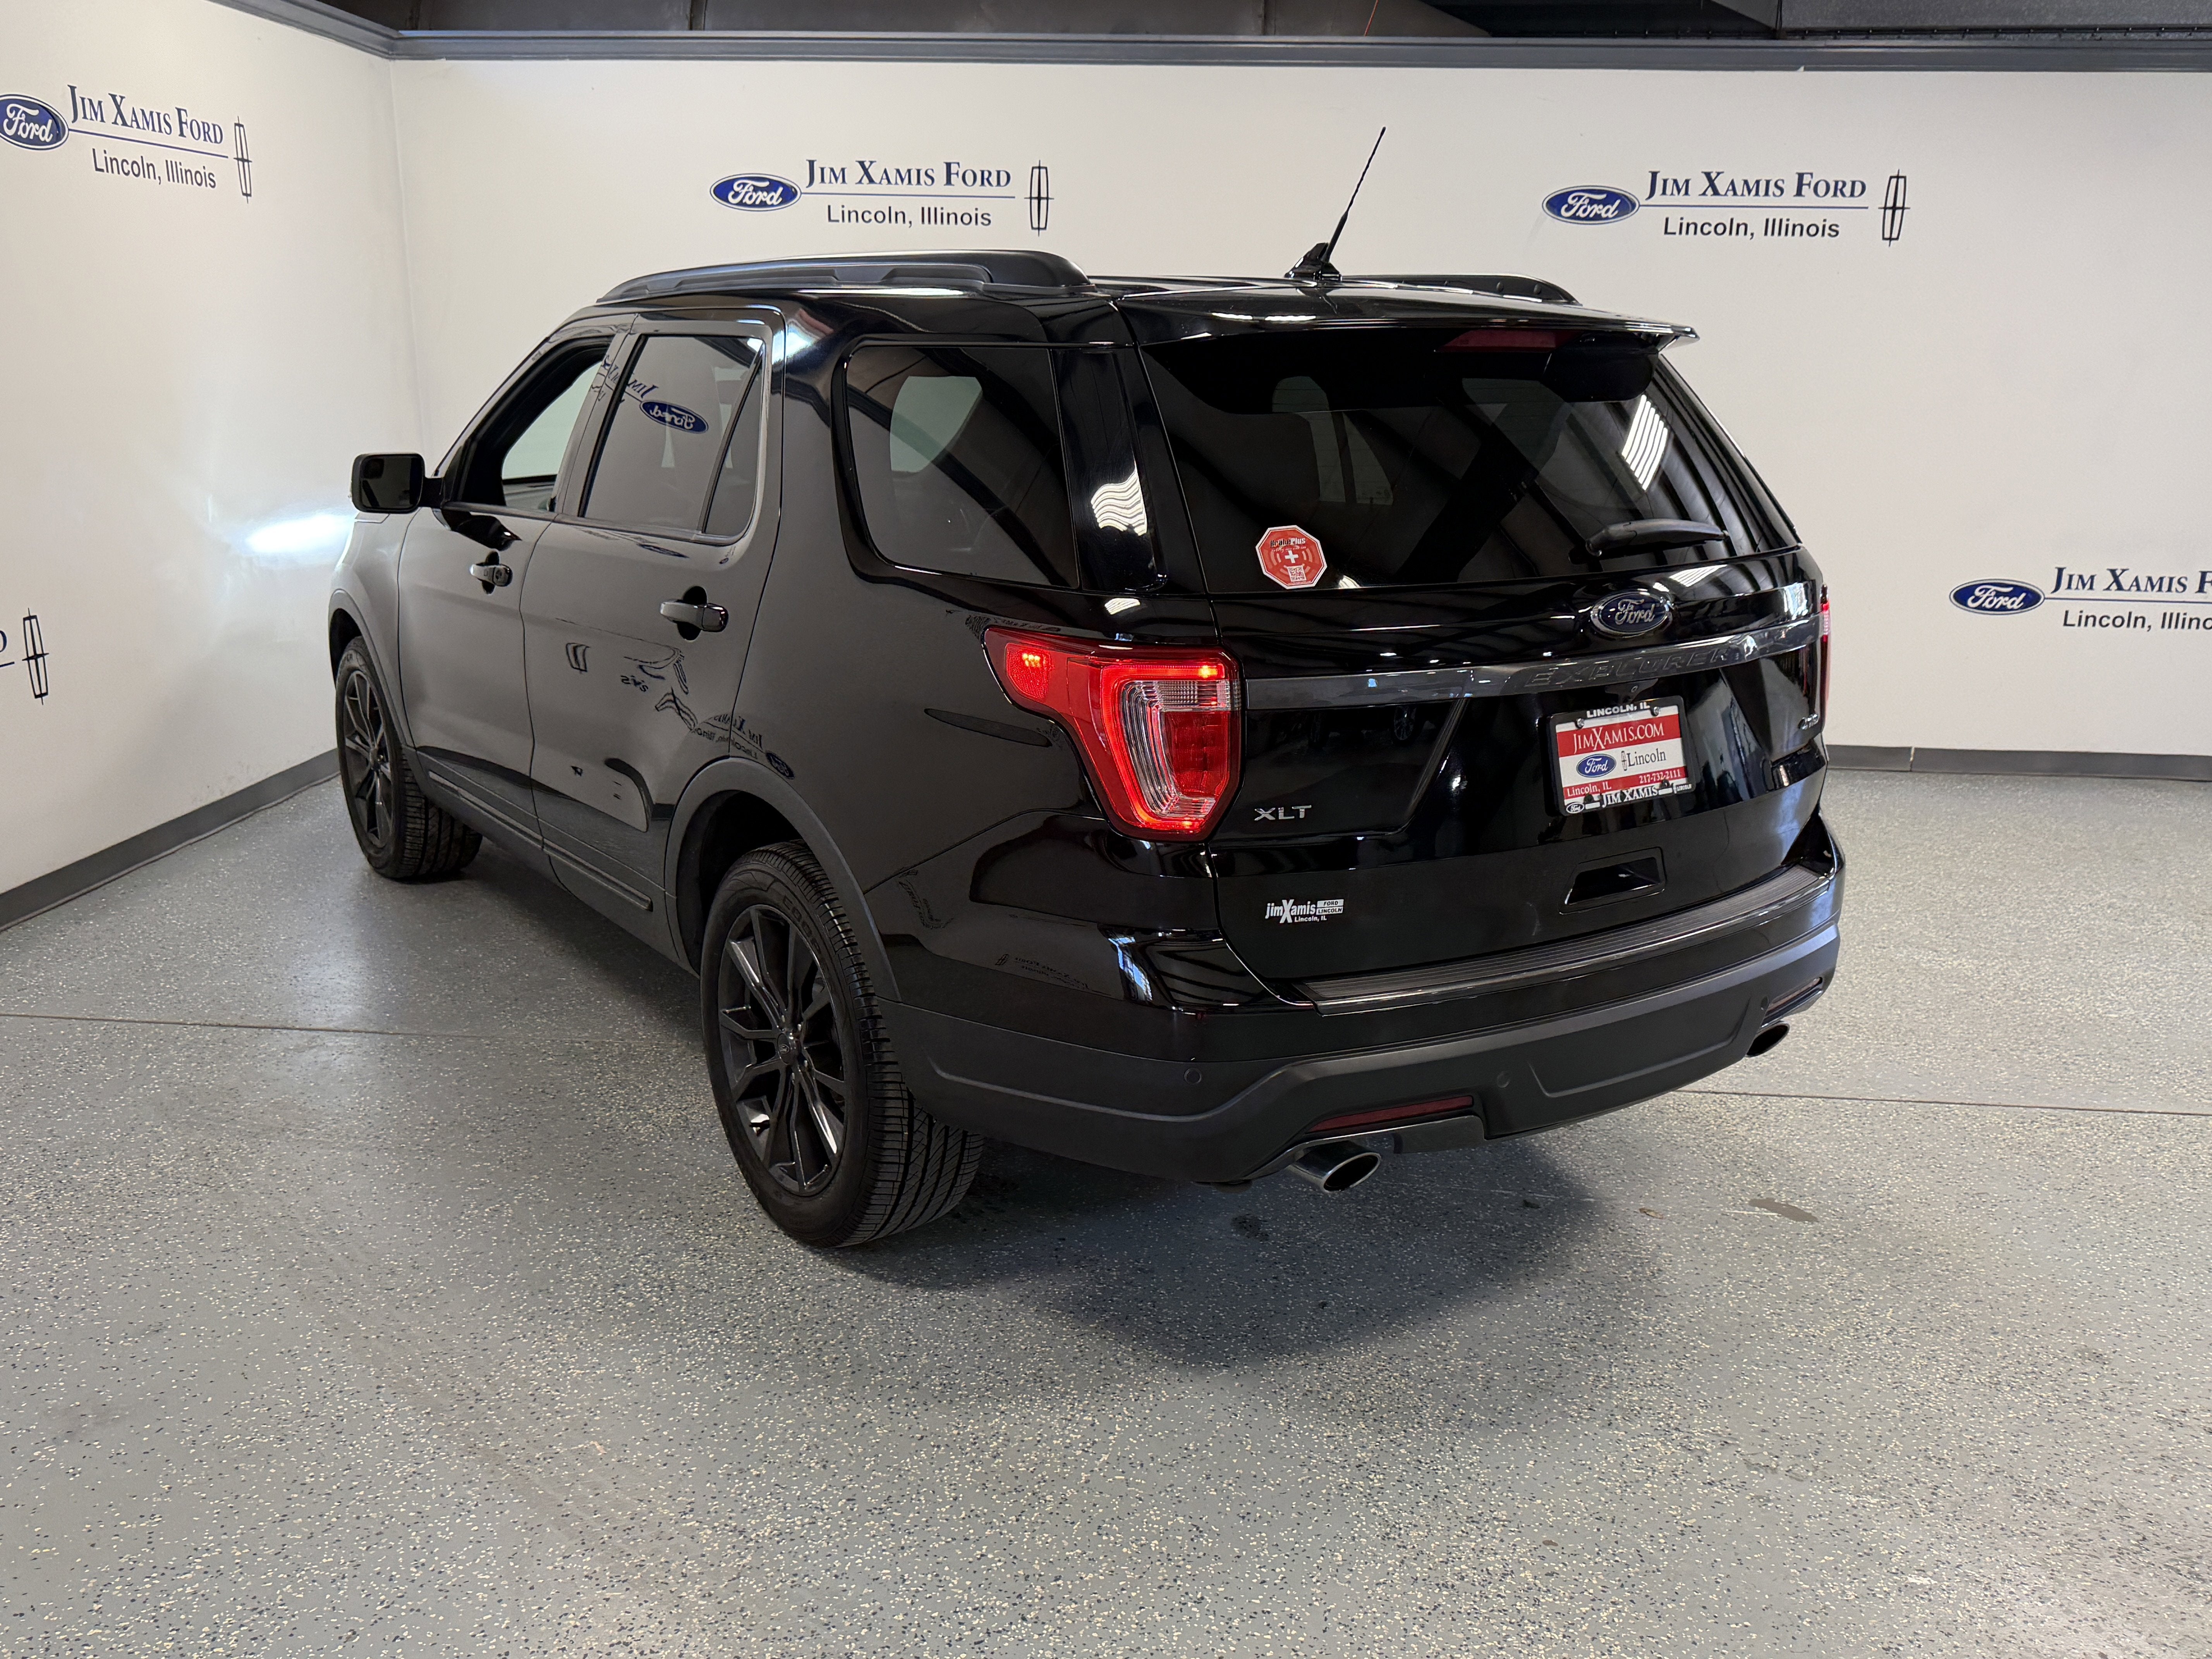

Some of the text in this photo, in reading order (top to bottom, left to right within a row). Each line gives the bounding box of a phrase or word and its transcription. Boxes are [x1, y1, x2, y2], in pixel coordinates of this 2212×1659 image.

[3, 103, 53, 143] Ford
[67, 84, 223, 144] JIM XAMIS FORD
[92, 148, 216, 189] Lincoln, Illinois
[806, 159, 1012, 189] JIM XAMIS FORD
[727, 179, 783, 206] Ford
[1645, 170, 1867, 201] JIM XAMIS FORD
[827, 204, 992, 228] Lincoln, Illinois
[1560, 192, 1619, 219] Ford
[1664, 216, 1840, 240] Lincoln, Illinois
[2050, 566, 2097, 594] JIM
[2103, 568, 2188, 593] XAMIS
[1967, 585, 2027, 610] Ford
[1615, 598, 1656, 625] Ford
[2063, 610, 2212, 631] Lincoln, Illino
[1587, 702, 1650, 718] LINCOLN, IL
[1573, 723, 1664, 754] JIMXAMIS.COM
[1584, 759, 1609, 774] Ford
[1626, 748, 1666, 767] Lincoln
[1566, 782, 1612, 797] Lincoln, IL
[1638, 769, 1681, 785] 217-732-2111
[1602, 786, 1659, 808] JIM XAMIS
[1254, 805, 1312, 821] XLT
